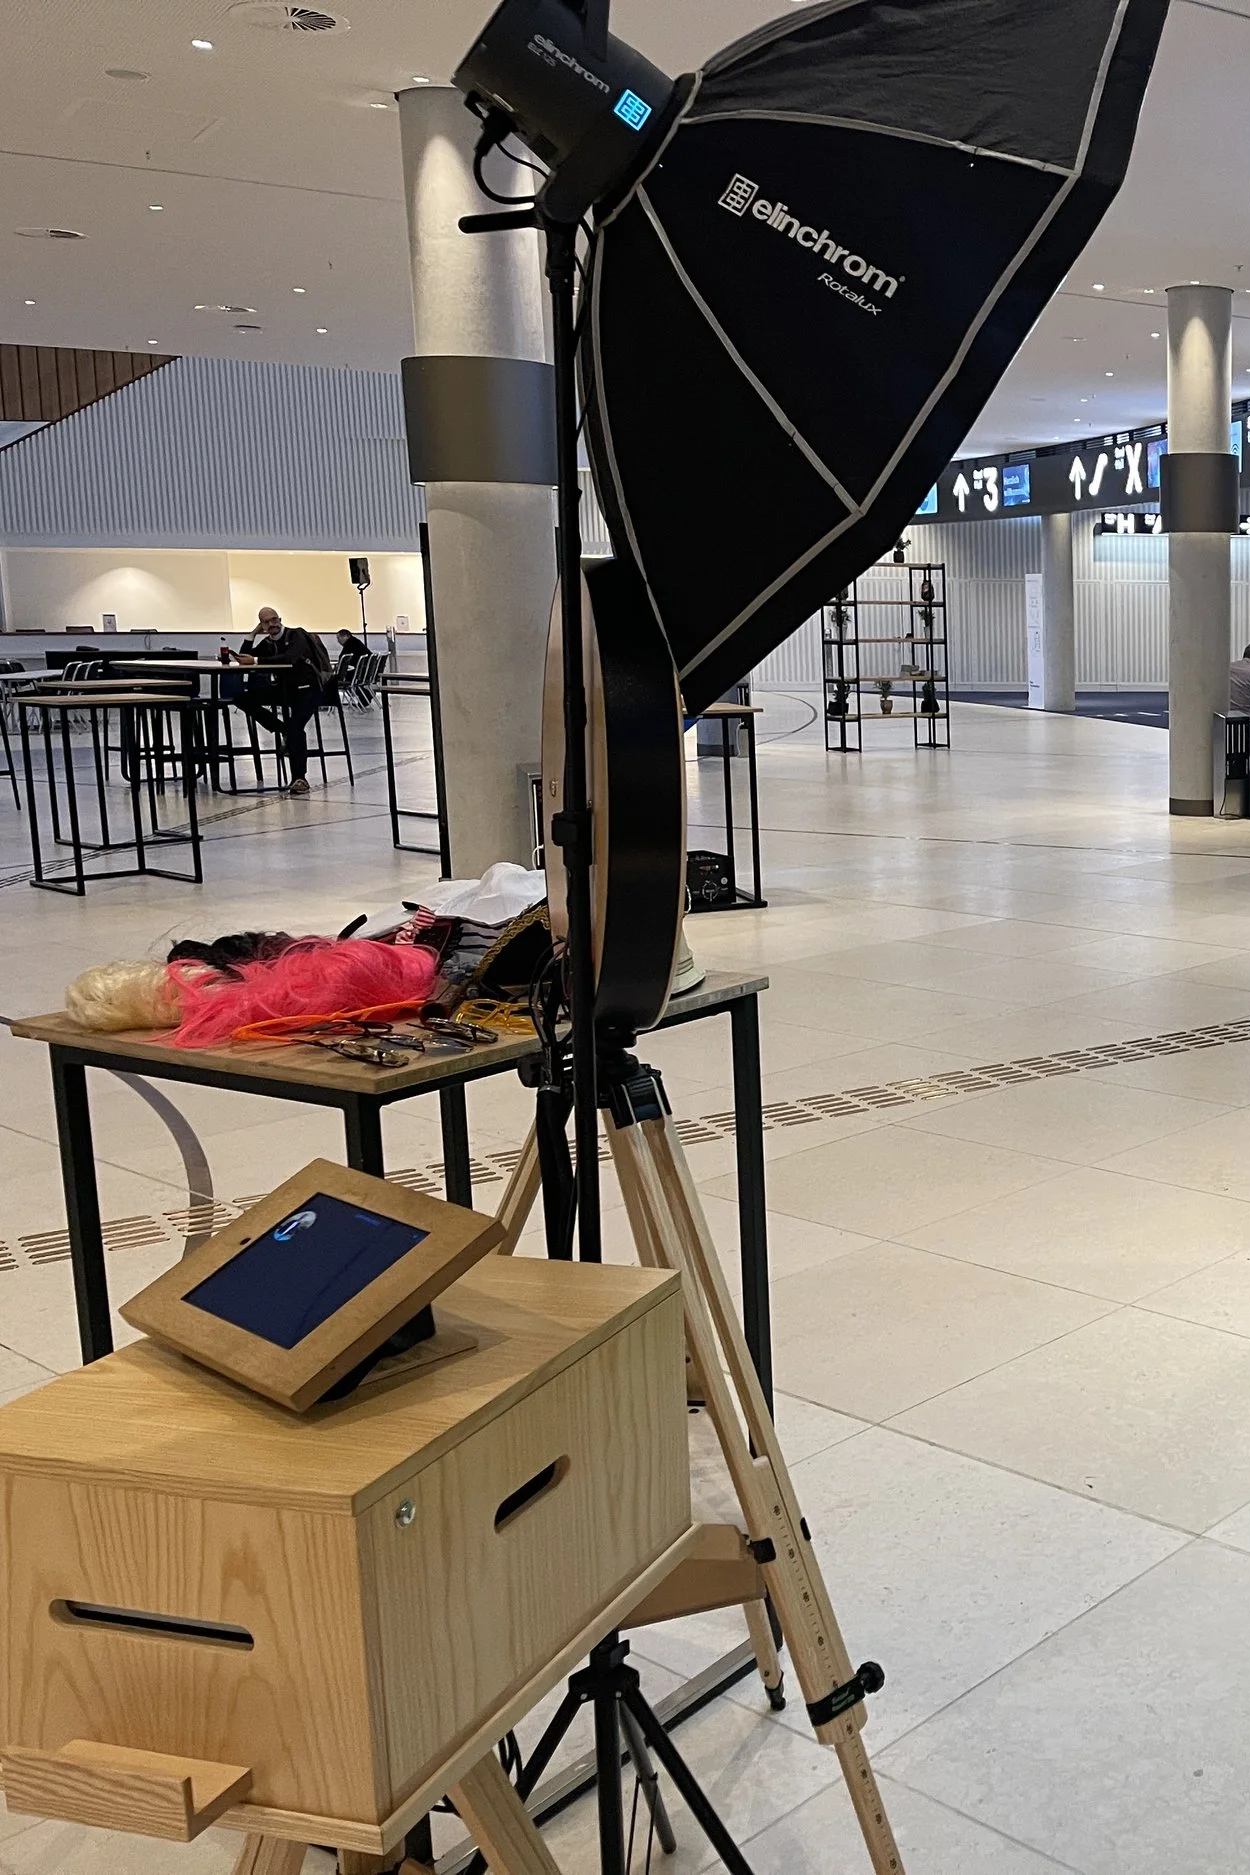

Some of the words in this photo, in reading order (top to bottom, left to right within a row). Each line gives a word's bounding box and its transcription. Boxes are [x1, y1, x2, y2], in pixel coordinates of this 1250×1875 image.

[534, 34, 610, 93] elinchrom
[752, 199, 898, 298] elinchrom
[817, 272, 882, 315] Rotalux
[983, 466, 999, 512] 3
[1125, 442, 1143, 495] X
[1117, 513, 1135, 534] H
